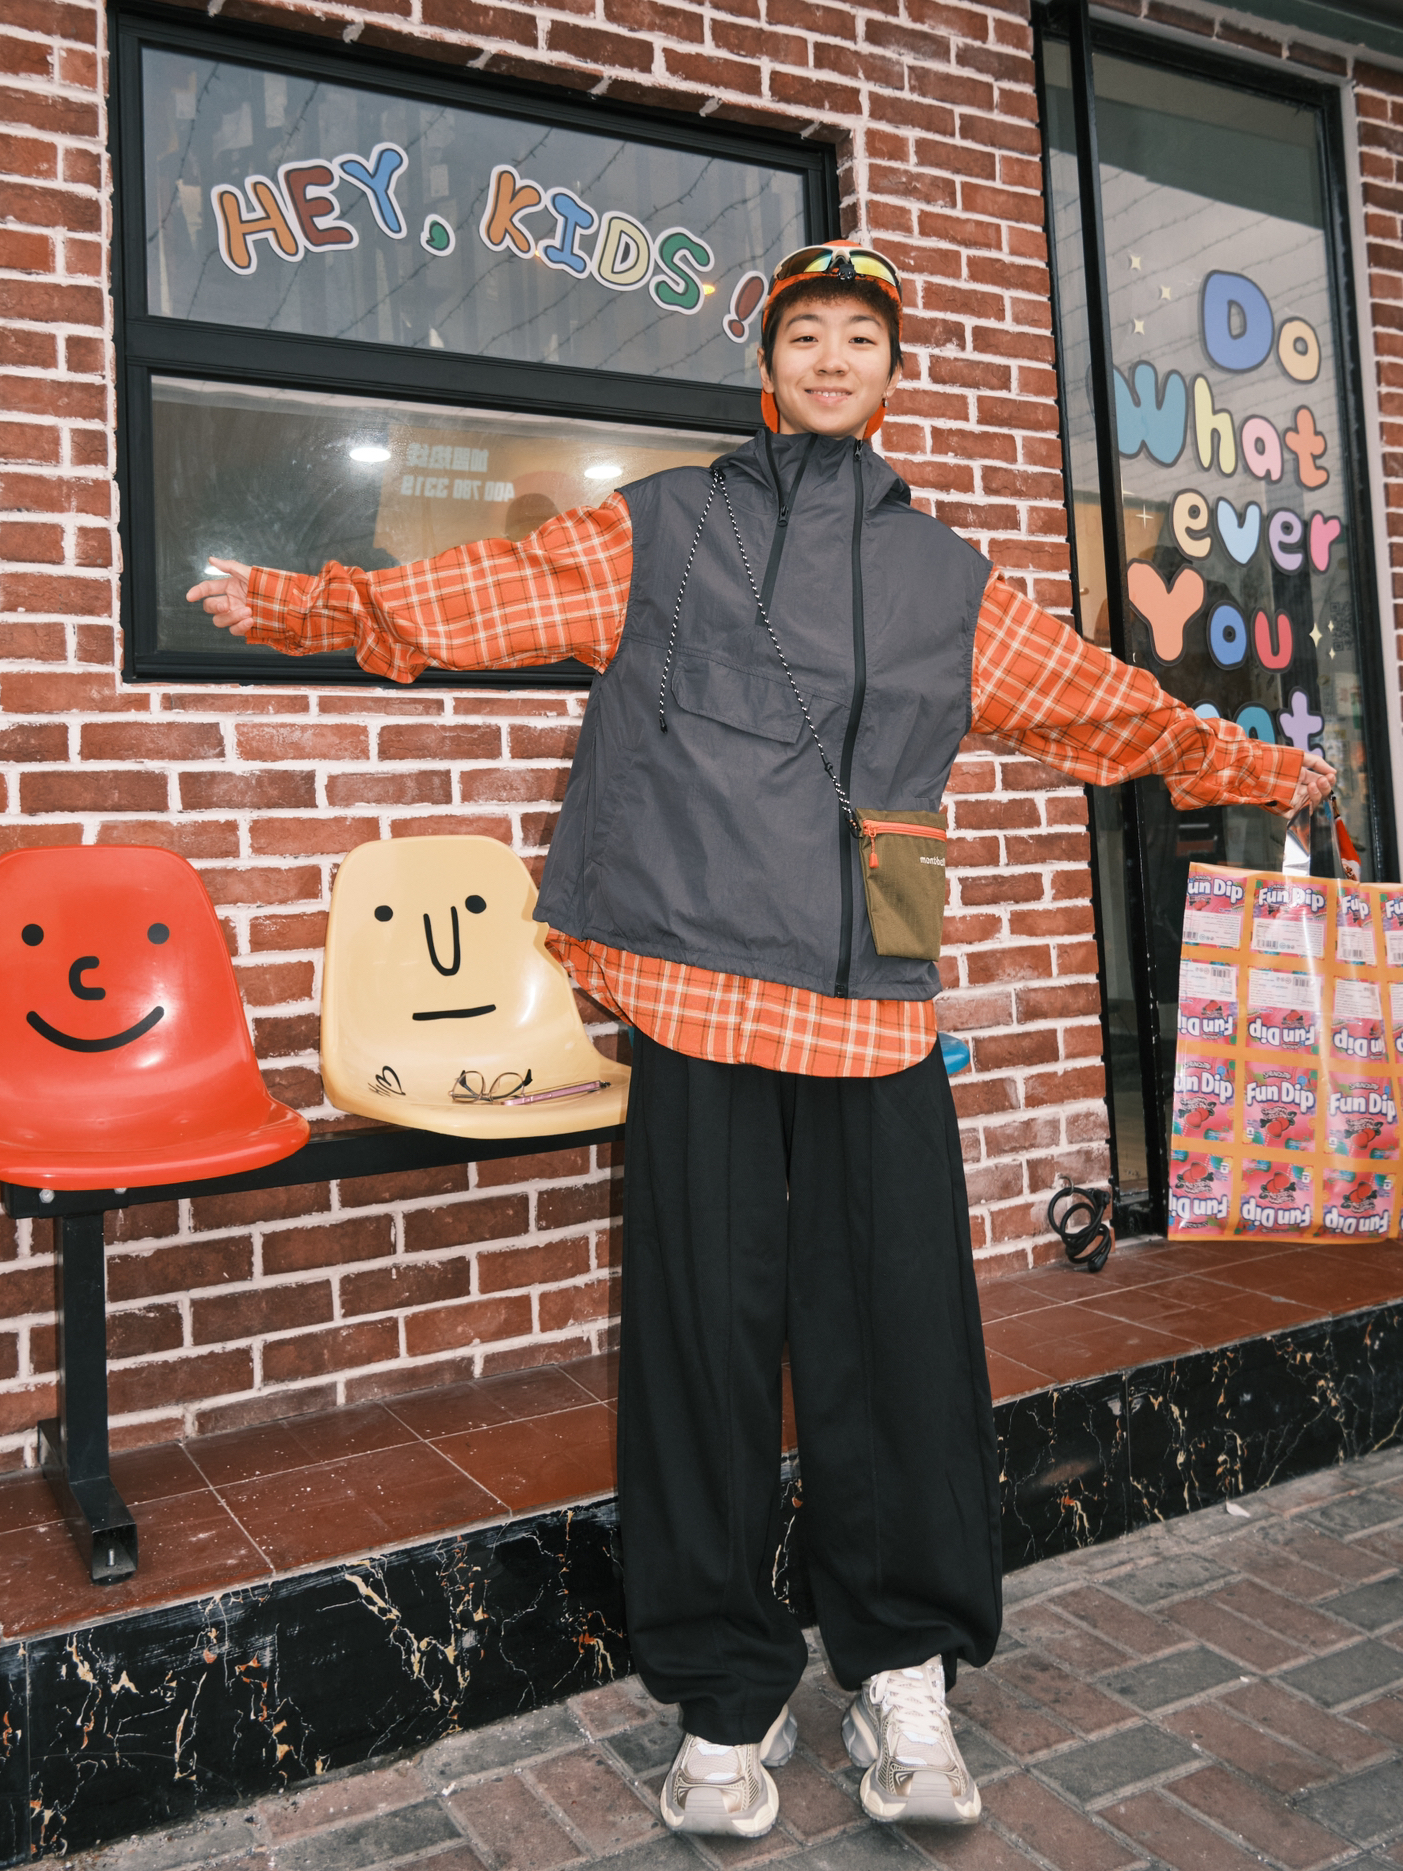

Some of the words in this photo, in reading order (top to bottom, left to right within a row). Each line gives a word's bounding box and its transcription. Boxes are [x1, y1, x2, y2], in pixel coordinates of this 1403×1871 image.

[211, 142, 455, 274] HEY,
[1202, 270, 1321, 383] Do
[1112, 360, 1330, 489] What
[1171, 489, 1341, 575] ever
[1126, 558, 1294, 673] You
[1213, 878, 1243, 904] Dip
[1258, 886, 1289, 906] Fun
[1292, 887, 1325, 912] Dip
[1178, 1006, 1200, 1036] Di
[1202, 1014, 1233, 1036] Fun
[1248, 1017, 1280, 1046] Dip
[1282, 1024, 1315, 1047] Fun
[1333, 1028, 1368, 1058] Dip
[1201, 1072, 1233, 1104] Dip
[1246, 1081, 1279, 1106] Fun
[1281, 1081, 1315, 1113] Dip
[1329, 1092, 1366, 1117] Fun
[1368, 1092, 1397, 1124] Dip
[1169, 1188, 1191, 1218] Di
[1193, 1194, 1227, 1219] Fun
[1242, 1196, 1275, 1228] Dip
[1277, 1204, 1311, 1227] Fun
[1325, 1206, 1357, 1235] Dip
[1358, 1209, 1389, 1235] Fun
